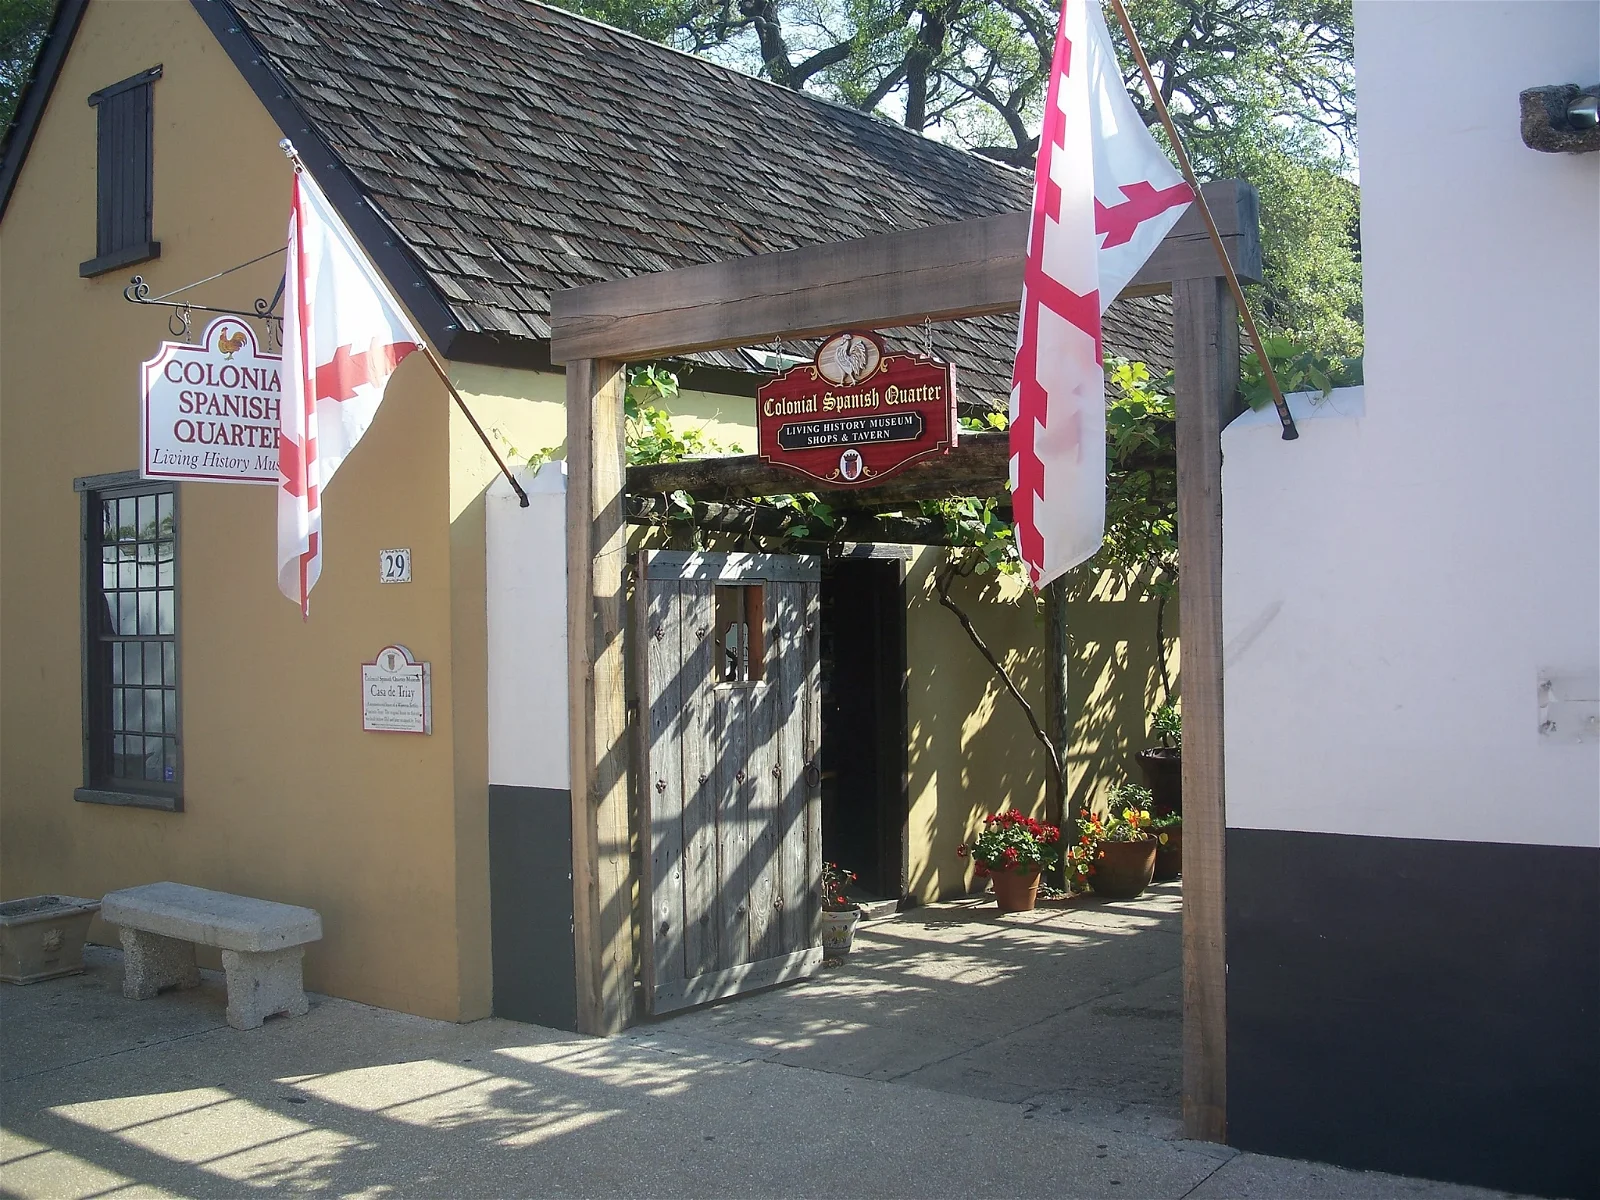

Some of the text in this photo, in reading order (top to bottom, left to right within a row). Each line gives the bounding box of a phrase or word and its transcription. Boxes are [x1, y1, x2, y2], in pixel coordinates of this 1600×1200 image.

[164, 359, 282, 393] COLONIA
[179, 390, 281, 420] SPANISH
[764, 384, 942, 417] Colonial Spanish Quarter
[786, 415, 913, 436] LIVING HISTORY MUSEUM
[807, 430, 891, 445] SHOPS & TAVERN
[152, 448, 280, 472] Living History Mus
[385, 554, 405, 578] 29
[370, 684, 415, 702] Casa de Triay
